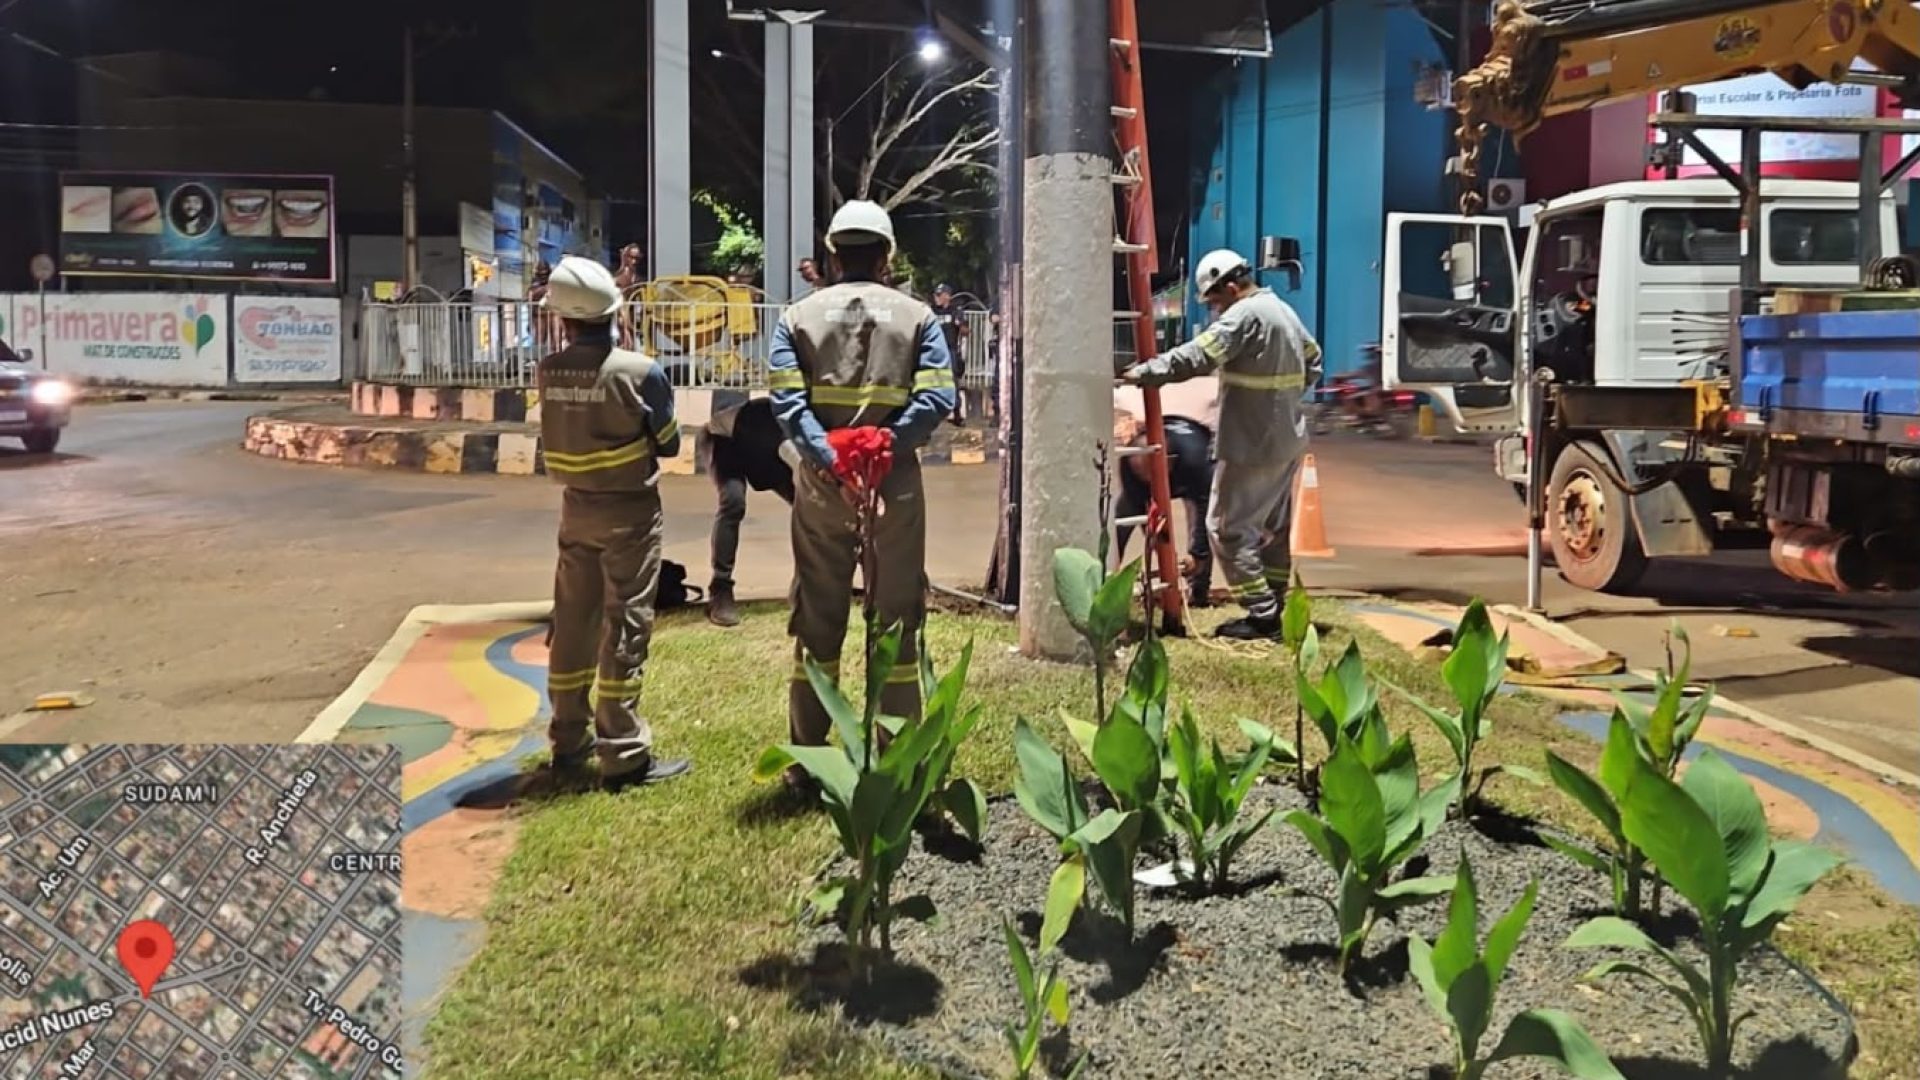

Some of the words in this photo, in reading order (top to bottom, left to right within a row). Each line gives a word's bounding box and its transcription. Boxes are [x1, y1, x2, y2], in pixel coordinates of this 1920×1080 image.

[1719, 91, 1761, 104] Escolar
[1765, 90, 1775, 102] &
[20, 304, 179, 343] Primavera
